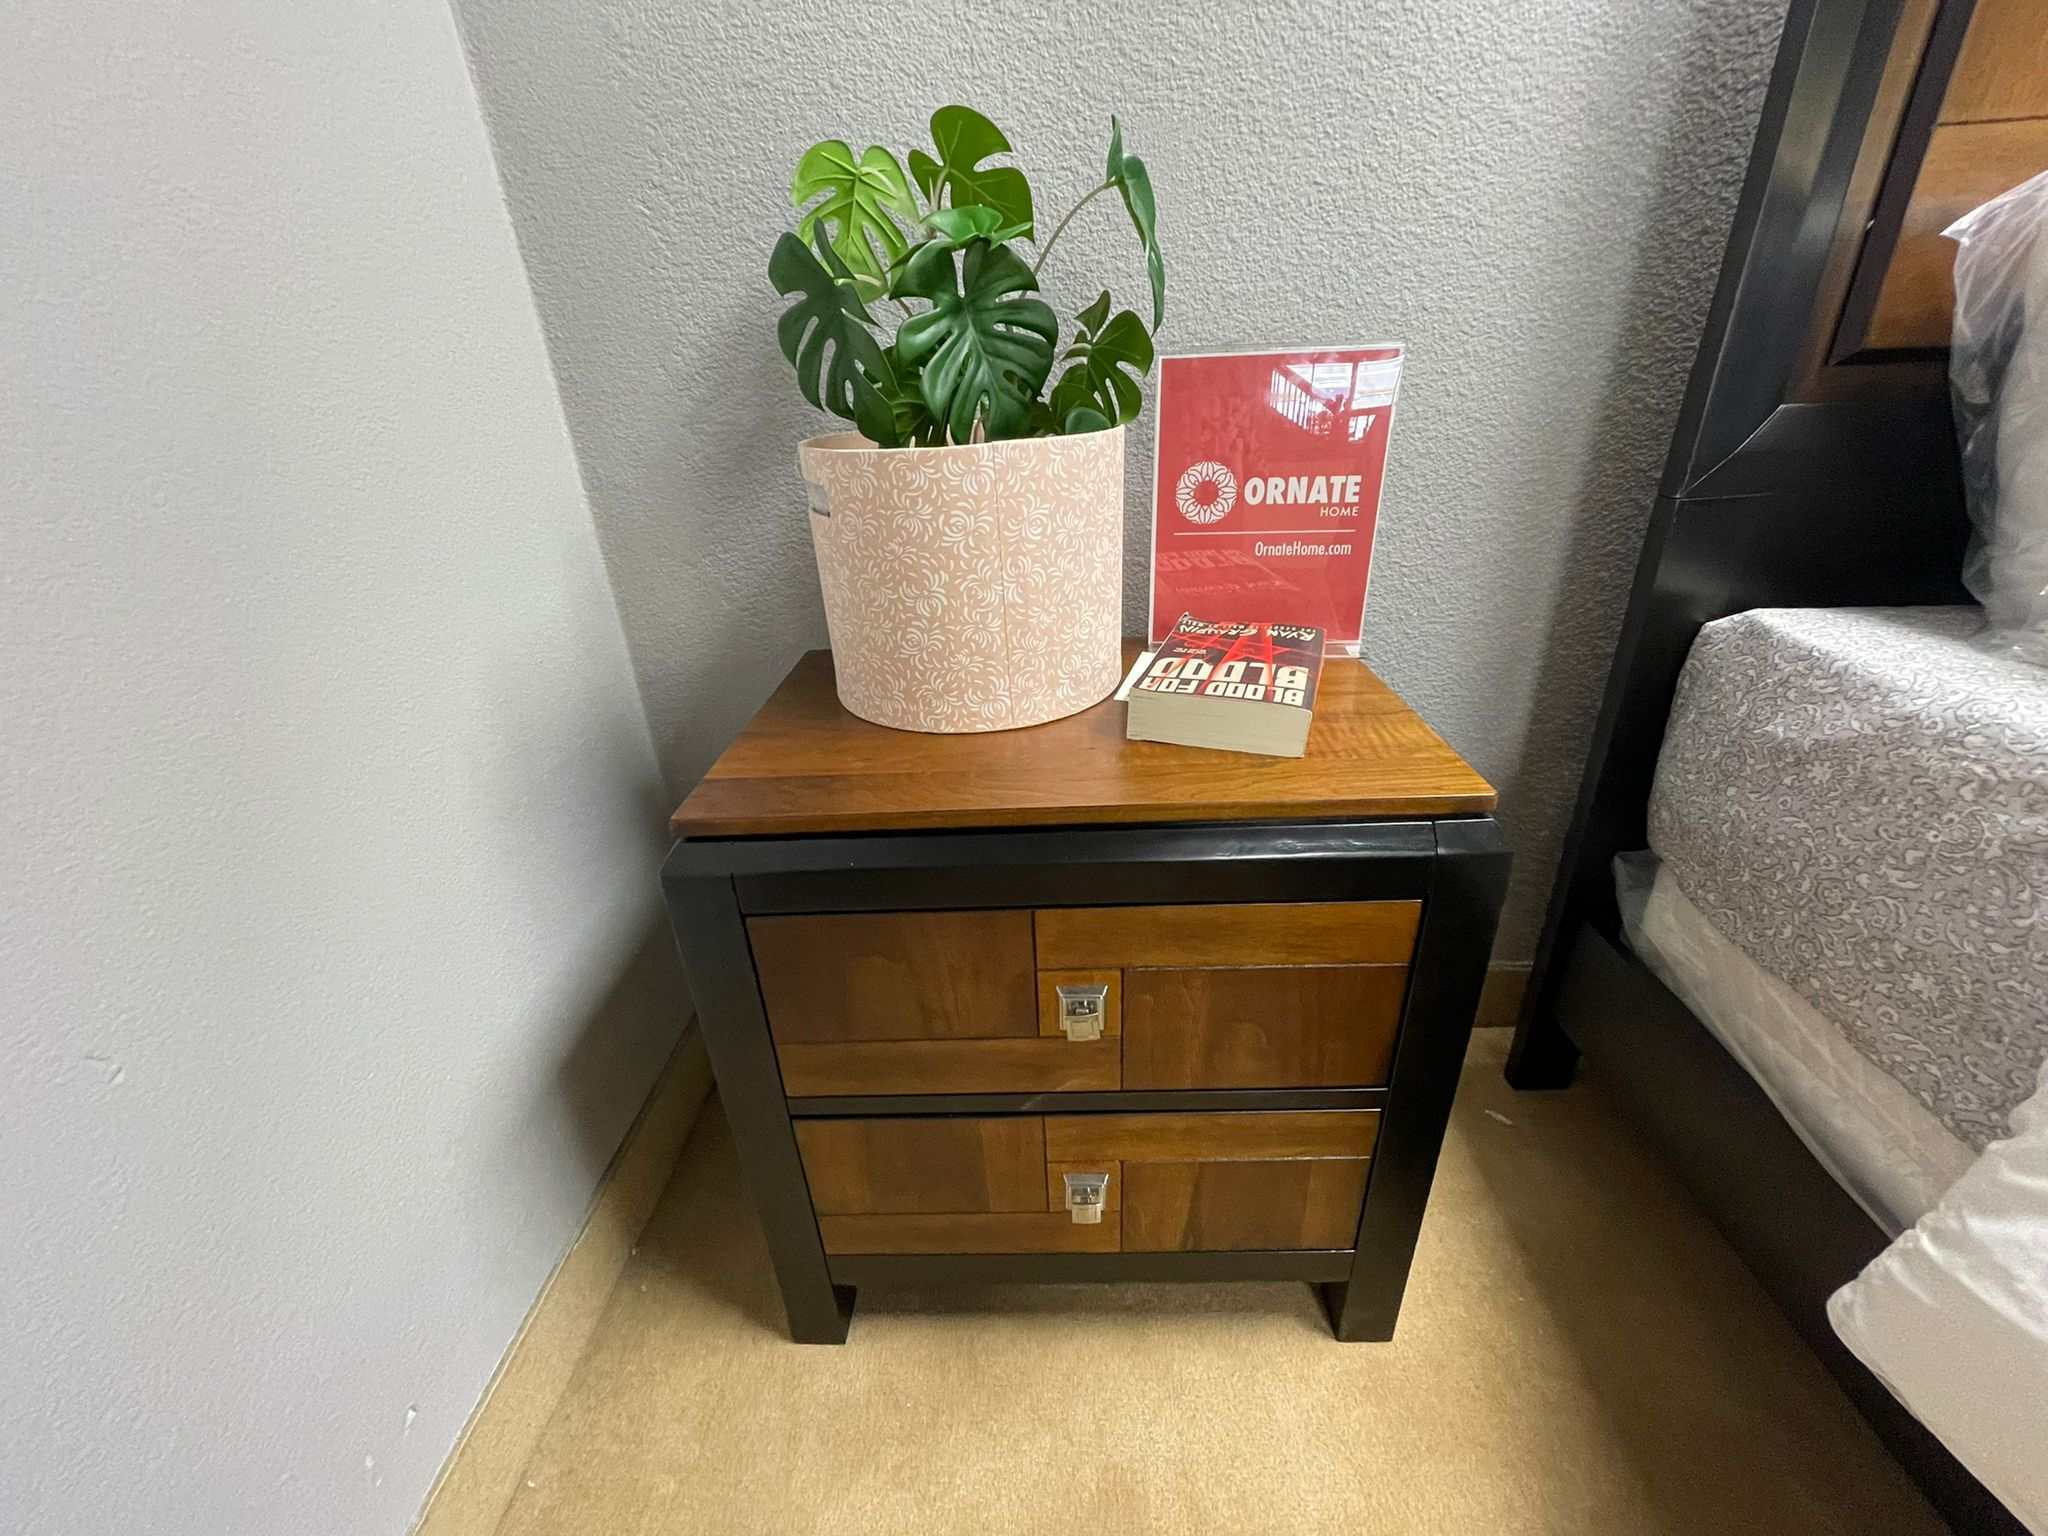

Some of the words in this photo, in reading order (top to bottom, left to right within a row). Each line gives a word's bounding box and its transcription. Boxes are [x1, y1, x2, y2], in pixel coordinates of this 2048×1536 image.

[1244, 475, 1362, 505] ORNATE
[1320, 506, 1360, 517] HOME
[1255, 541, 1352, 557] OrnateHome.com
[1266, 629, 1316, 642] RYAN
[1148, 658, 1308, 690] BLOOD
[1139, 677, 1199, 693] FOR
[1204, 681, 1305, 707] BLOOD
